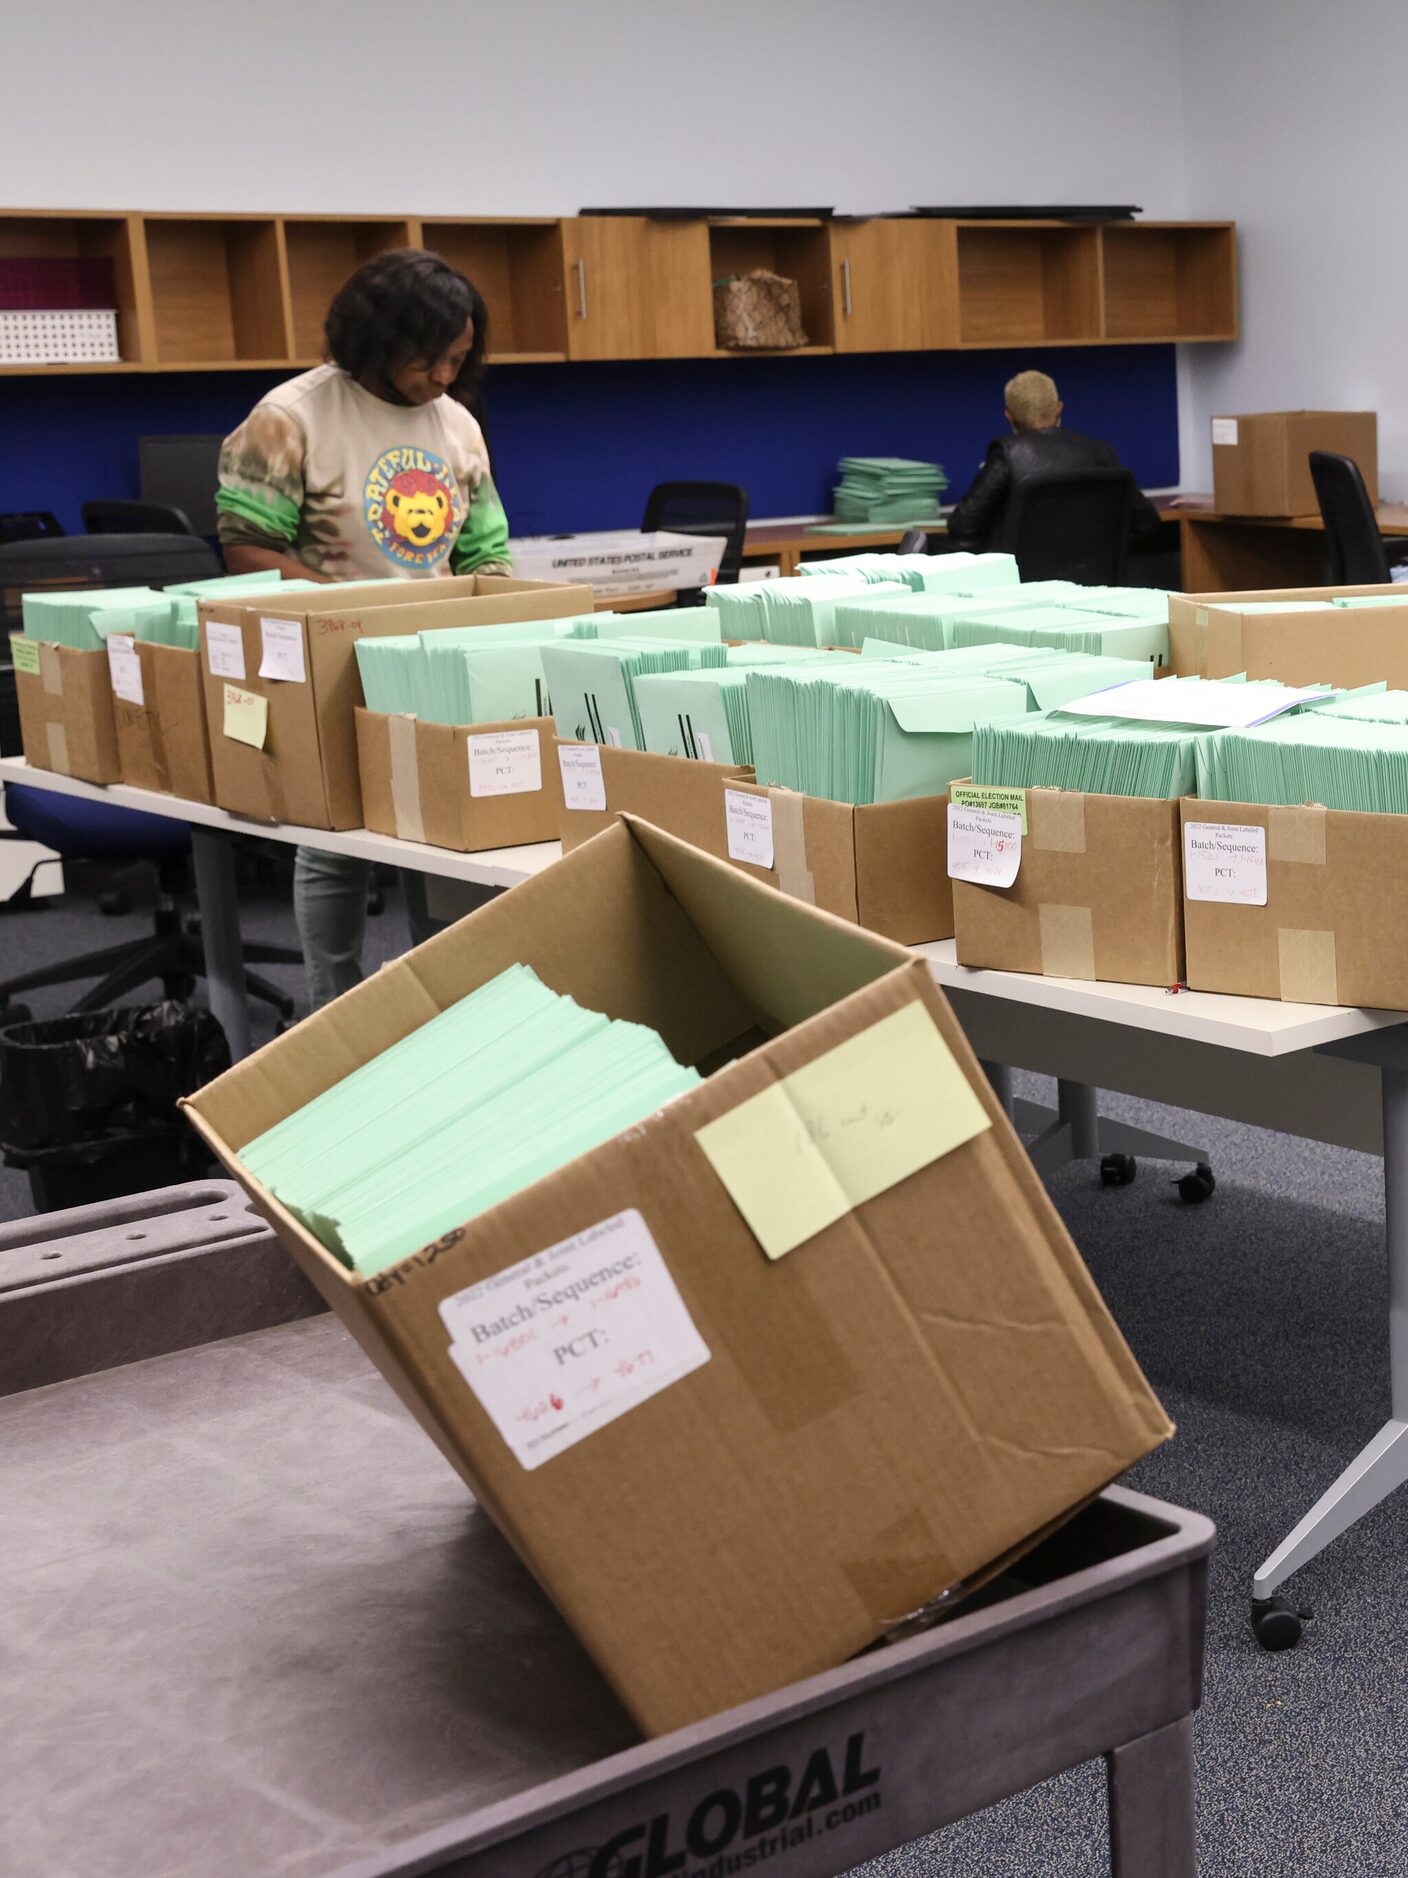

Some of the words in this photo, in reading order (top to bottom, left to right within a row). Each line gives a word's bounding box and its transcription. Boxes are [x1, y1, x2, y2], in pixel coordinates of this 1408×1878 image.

[552, 557, 586, 569] UNITED
[587, 555, 622, 566] STATES
[624, 551, 655, 563] POSTAL
[657, 547, 692, 560] SERVICE
[955, 790, 980, 800] OFFICIAL
[981, 792, 1010, 801] ELECTION
[1010, 794, 1023, 802] MAIL
[952, 820, 1016, 840] Batch/Sequence:
[973, 849, 993, 861] PCT:
[1191, 840, 1259, 853] Batch/Sequence:
[1214, 867, 1236, 879] PCT:
[485, 1264, 532, 1293] General
[577, 1217, 626, 1247] Labeled
[522, 1264, 570, 1291] Packets
[469, 1252, 643, 1345] Batch/Sequence:
[552, 1329, 612, 1367] PCT:
[587, 1730, 882, 1878] GLOBAL
[680, 1792, 881, 1878] industrial.com
